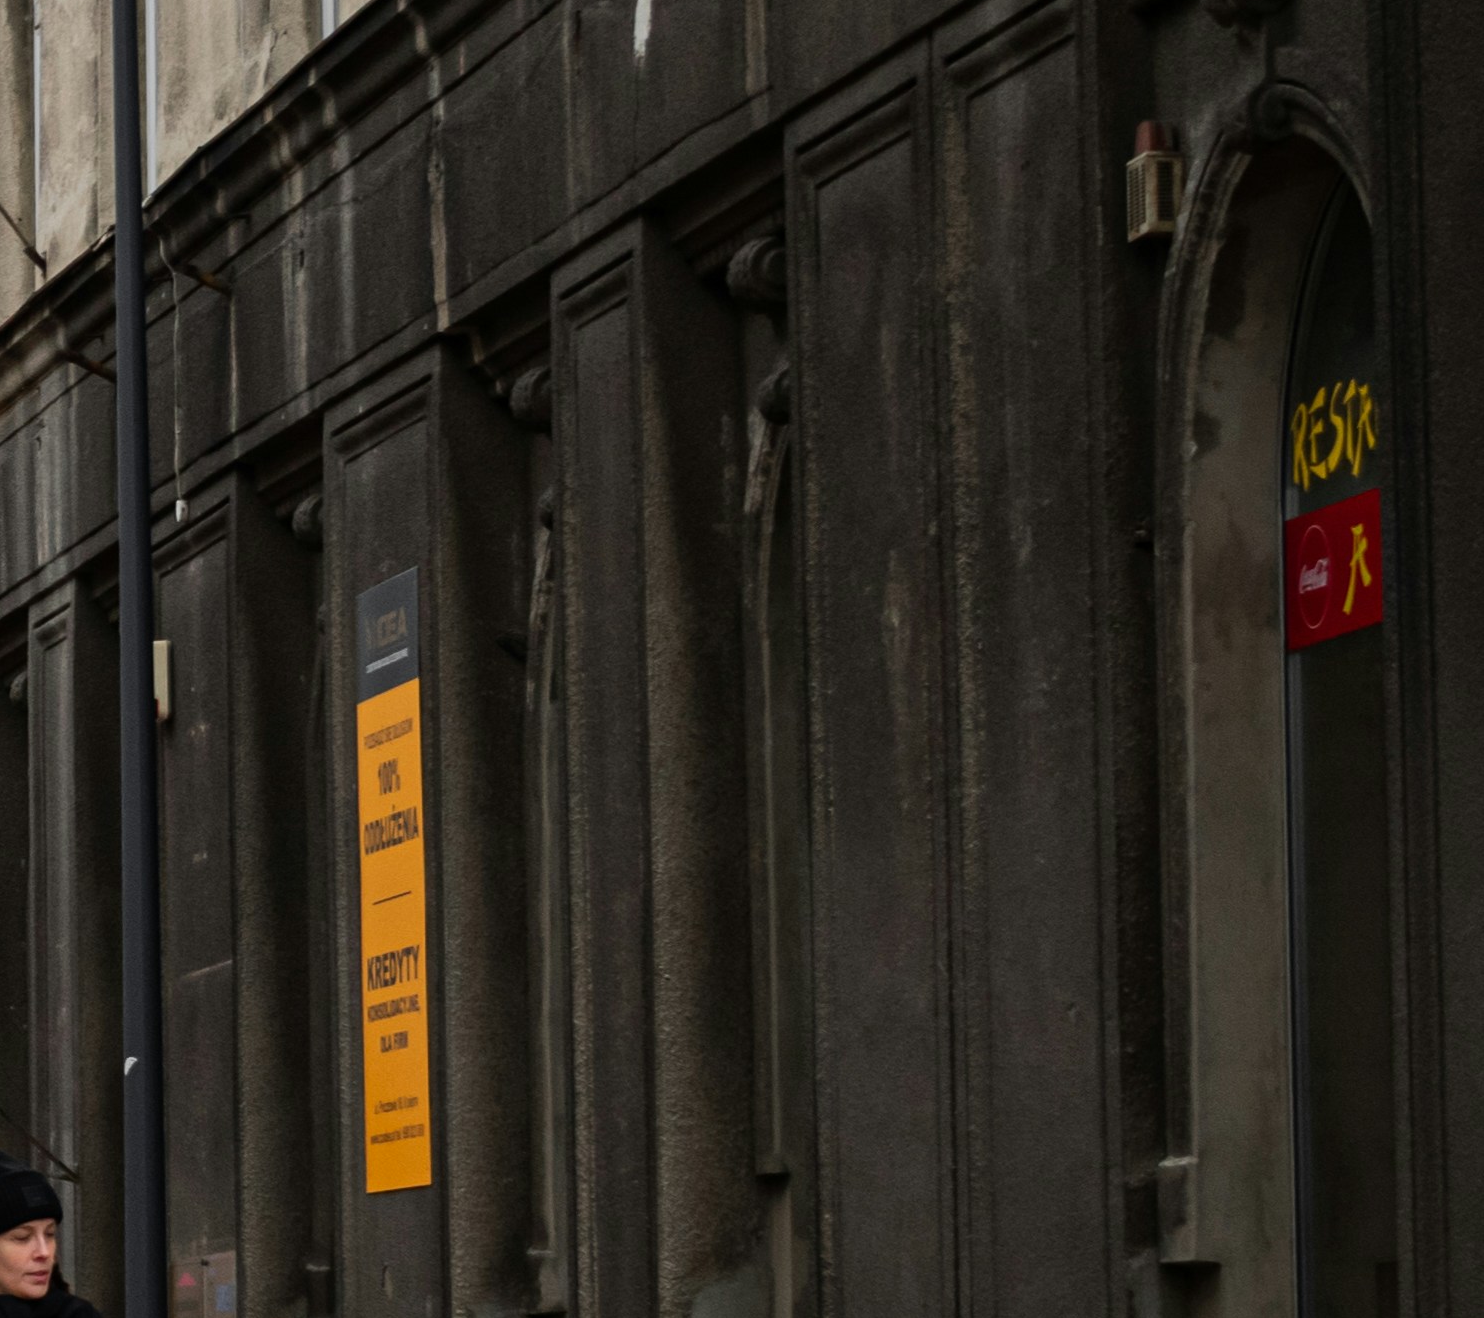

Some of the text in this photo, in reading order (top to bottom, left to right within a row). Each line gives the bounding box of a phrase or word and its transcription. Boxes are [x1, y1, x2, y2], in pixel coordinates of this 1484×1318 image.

[378, 758, 401, 795] 100%
[364, 803, 419, 856] ODDŁUŻENIA
[367, 945, 420, 992] KREDYTY
